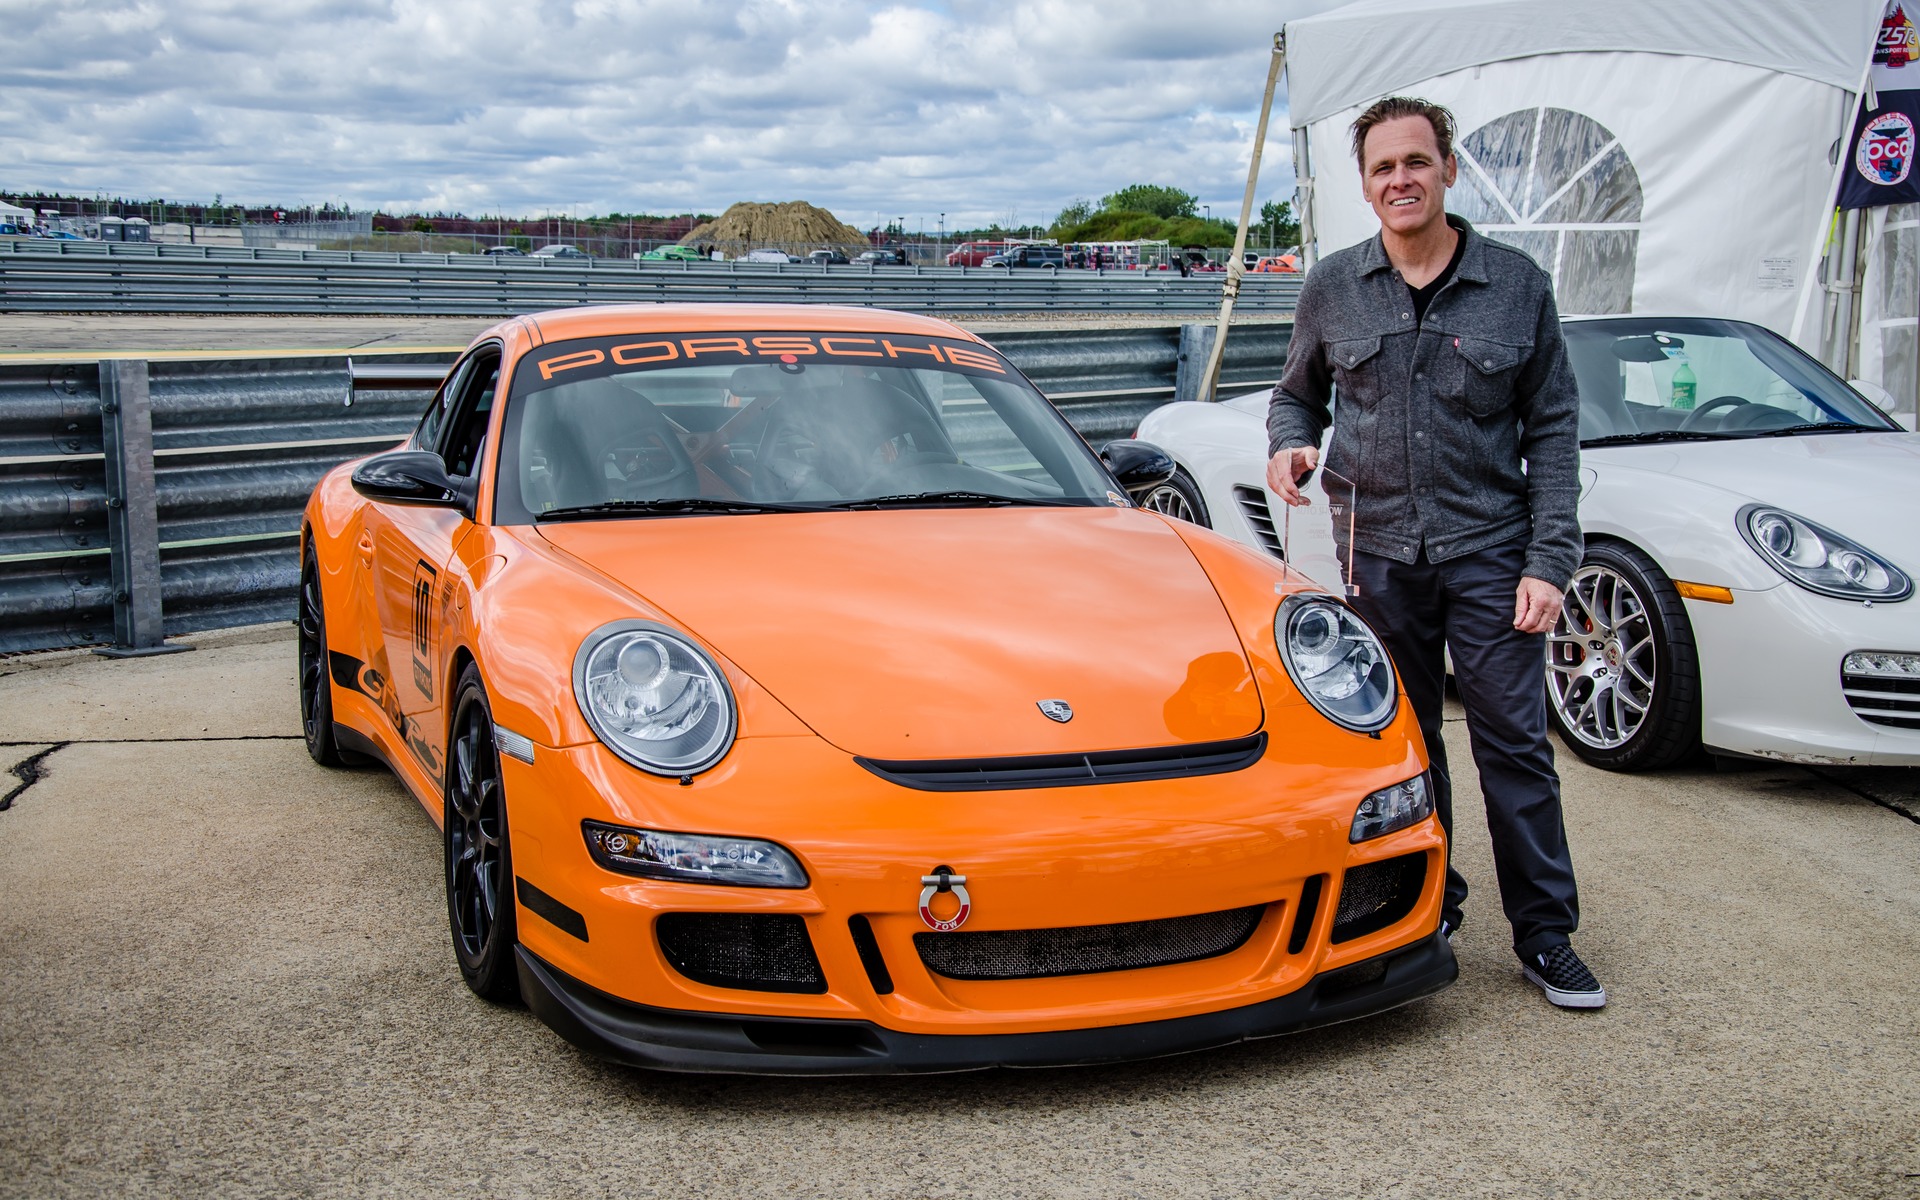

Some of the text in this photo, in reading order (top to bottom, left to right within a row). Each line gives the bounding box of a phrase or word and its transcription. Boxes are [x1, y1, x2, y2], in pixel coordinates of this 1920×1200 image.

[537, 336, 1007, 381] PORSCHE
[415, 577, 430, 658] 10
[357, 661, 403, 729] GT3
[935, 921, 958, 930] TOW
